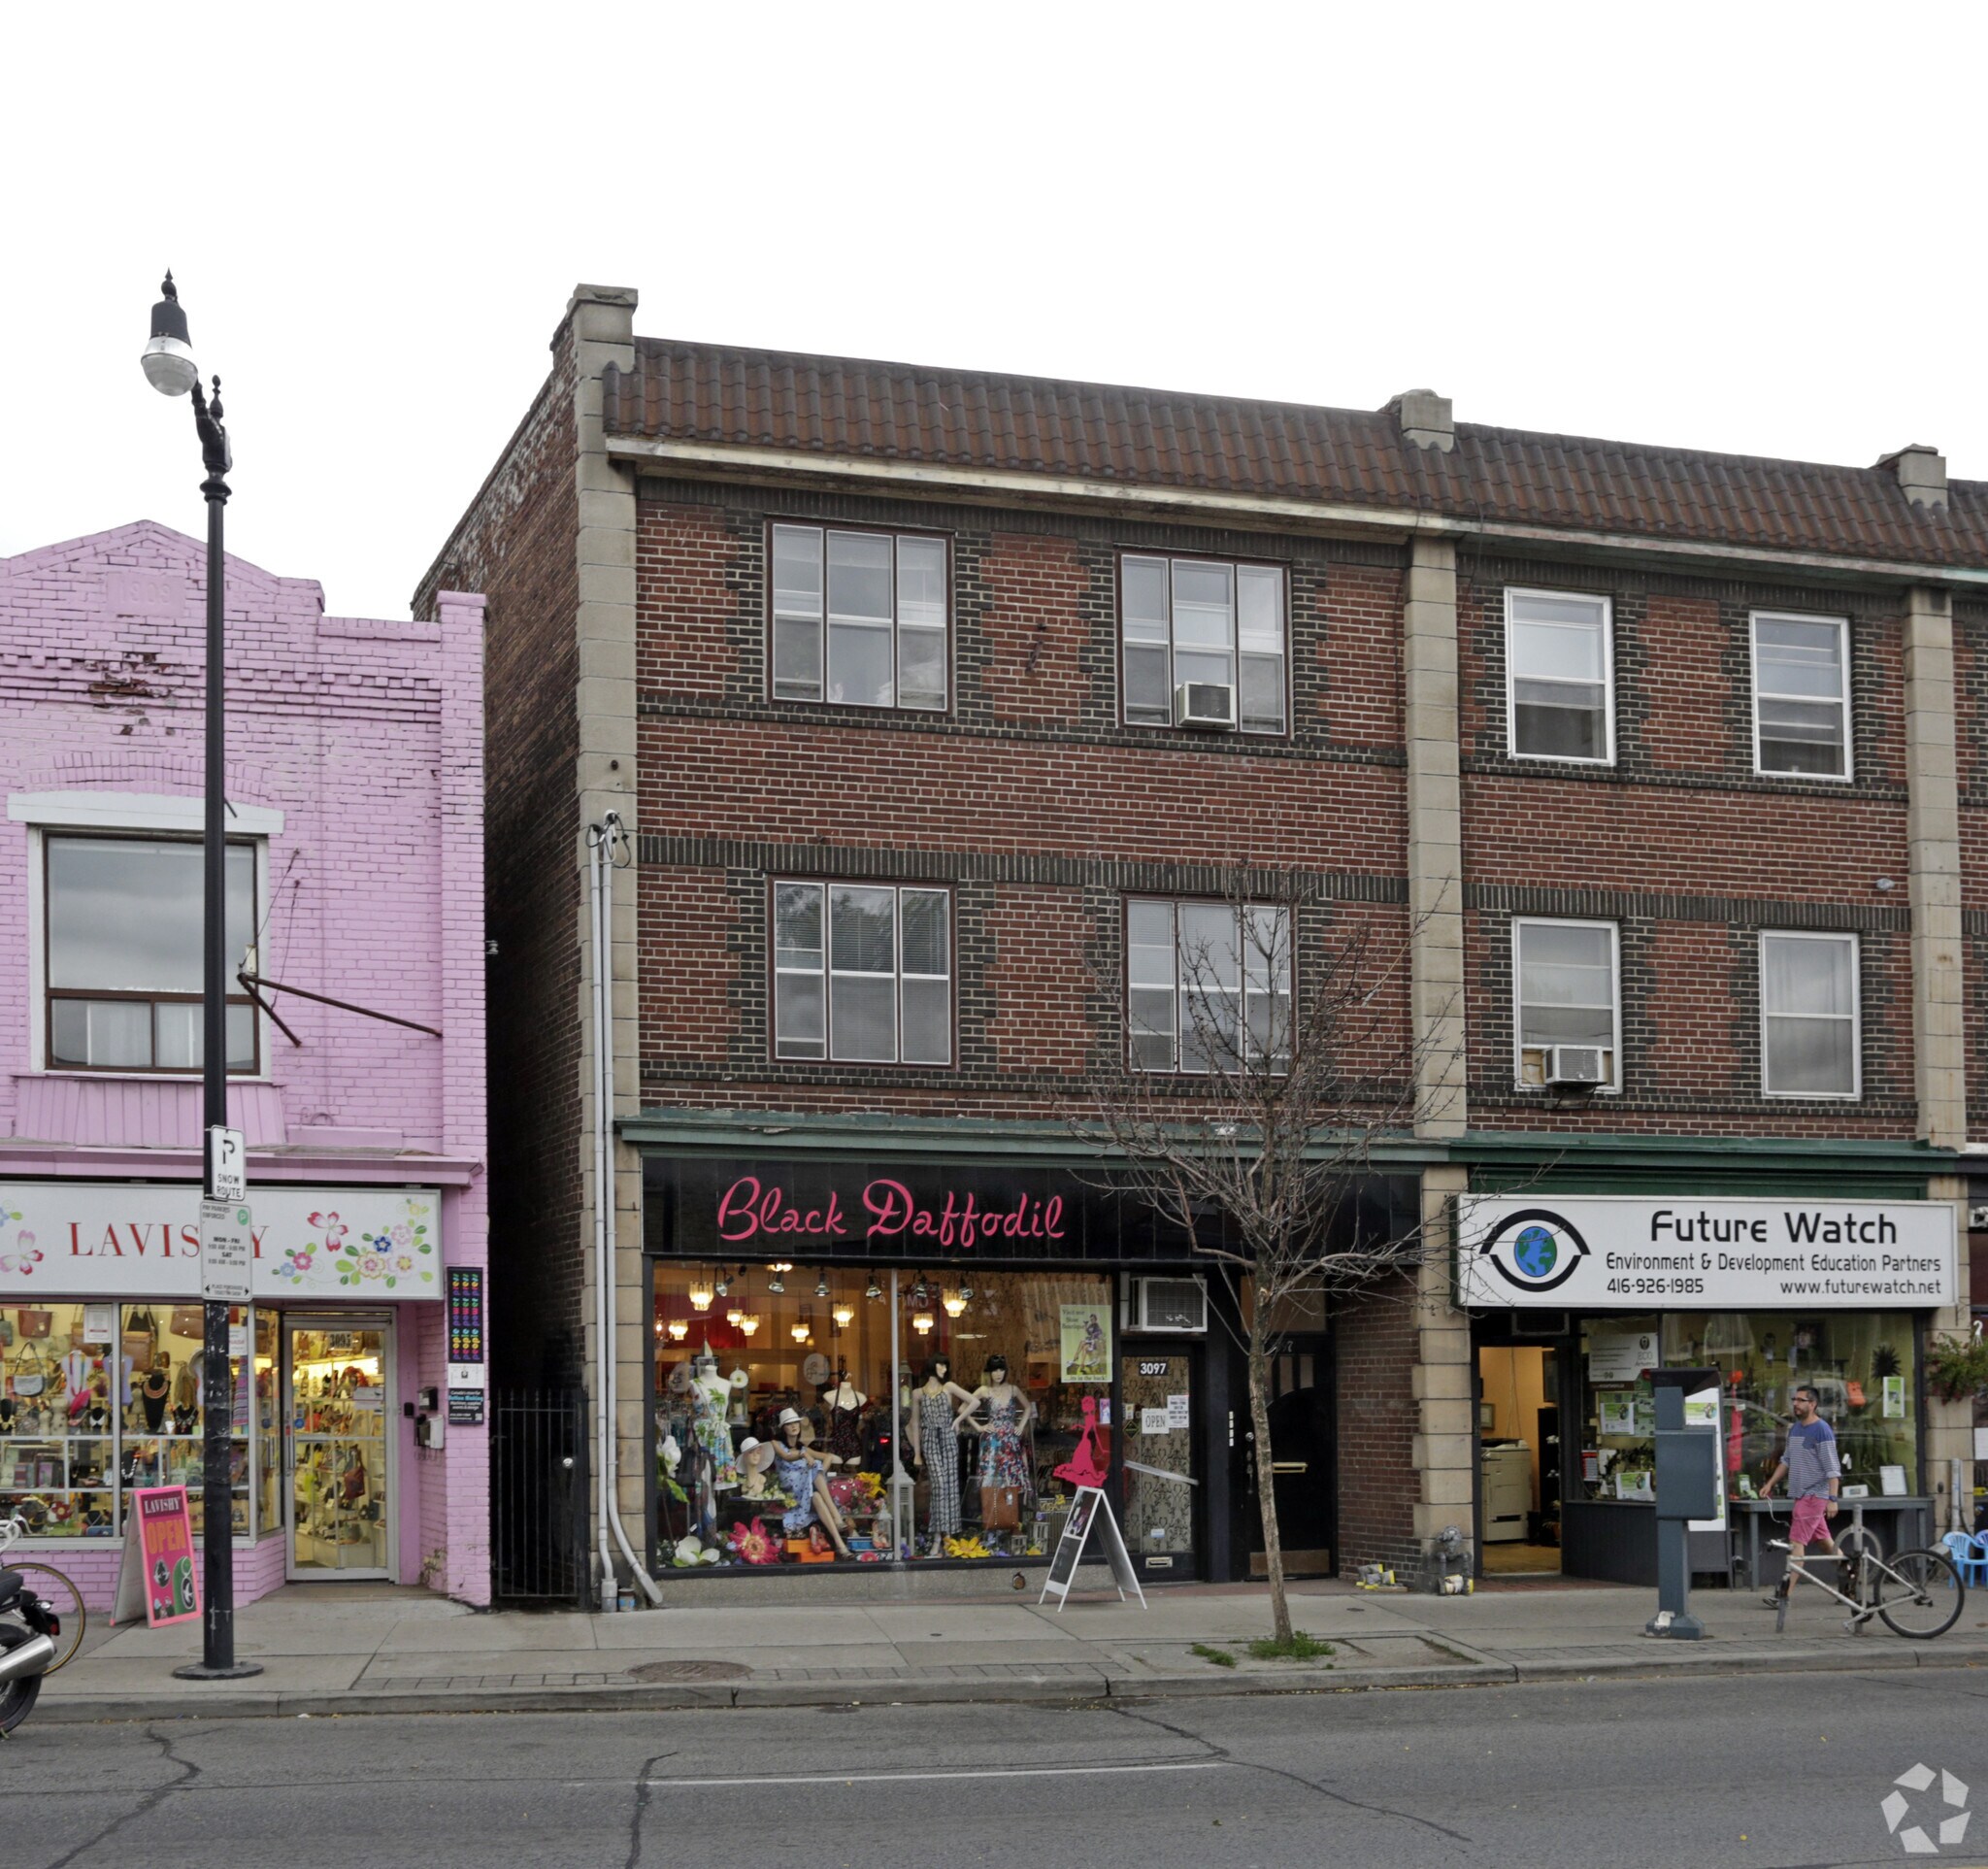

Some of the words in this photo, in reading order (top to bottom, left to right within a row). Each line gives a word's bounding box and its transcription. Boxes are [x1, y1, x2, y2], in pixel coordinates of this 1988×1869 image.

[217, 1173, 240, 1185] SNOW
[216, 1185, 241, 1198] ROUTE
[717, 1176, 847, 1241] Black
[862, 1179, 1065, 1248] Daffodil
[1651, 1210, 1767, 1243] Future
[1784, 1212, 1897, 1244] Watch
[67, 1222, 269, 1259] LAVISY
[1607, 1252, 1695, 1270] Environment
[1701, 1252, 1711, 1270] &
[1718, 1252, 1805, 1275] Development
[1811, 1254, 1876, 1271] Education
[1882, 1254, 1940, 1271] Partners
[1607, 1278, 1704, 1293] 416-926-1985
[1780, 1279, 1941, 1294] www.futurewatch.net
[1140, 1363, 1166, 1375] 3097
[1146, 1415, 1166, 1427] OPEN
[144, 1496, 181, 1514] LAVISHY
[147, 1519, 186, 1554] OPEN
